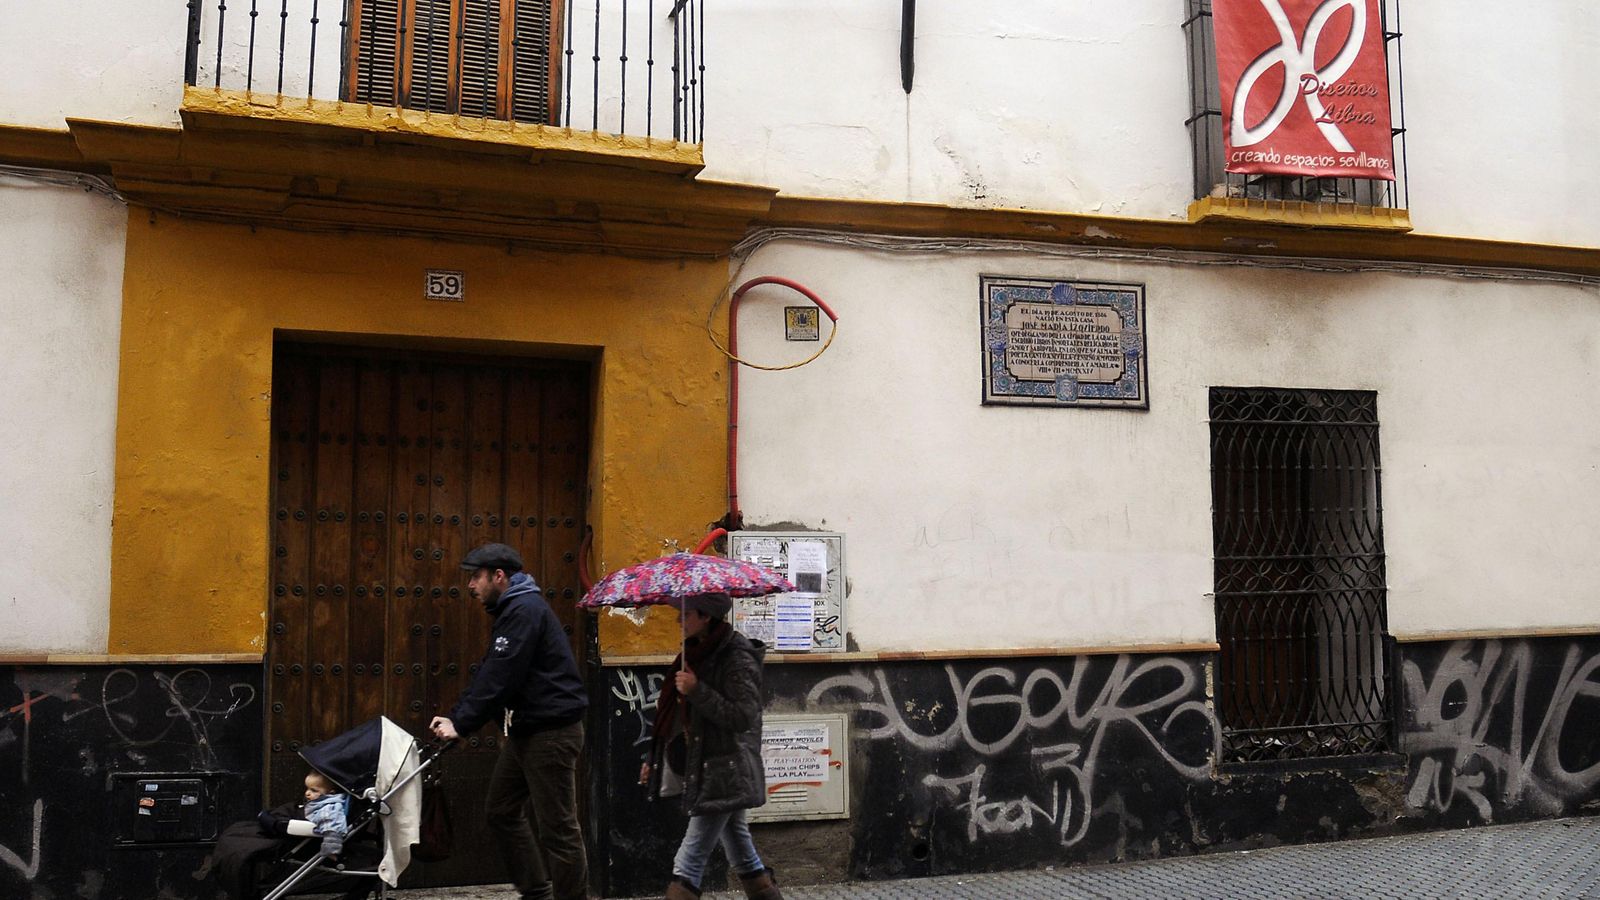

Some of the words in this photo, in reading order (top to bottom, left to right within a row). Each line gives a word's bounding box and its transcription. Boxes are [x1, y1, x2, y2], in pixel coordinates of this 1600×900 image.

[1300, 74, 1378, 97] Diseños
[1315, 102, 1376, 124] Libra
[1231, 147, 1281, 164] creando
[1283, 153, 1336, 168] espacios
[1339, 152, 1389, 169] sevillanos
[430, 276, 460, 295] 59
